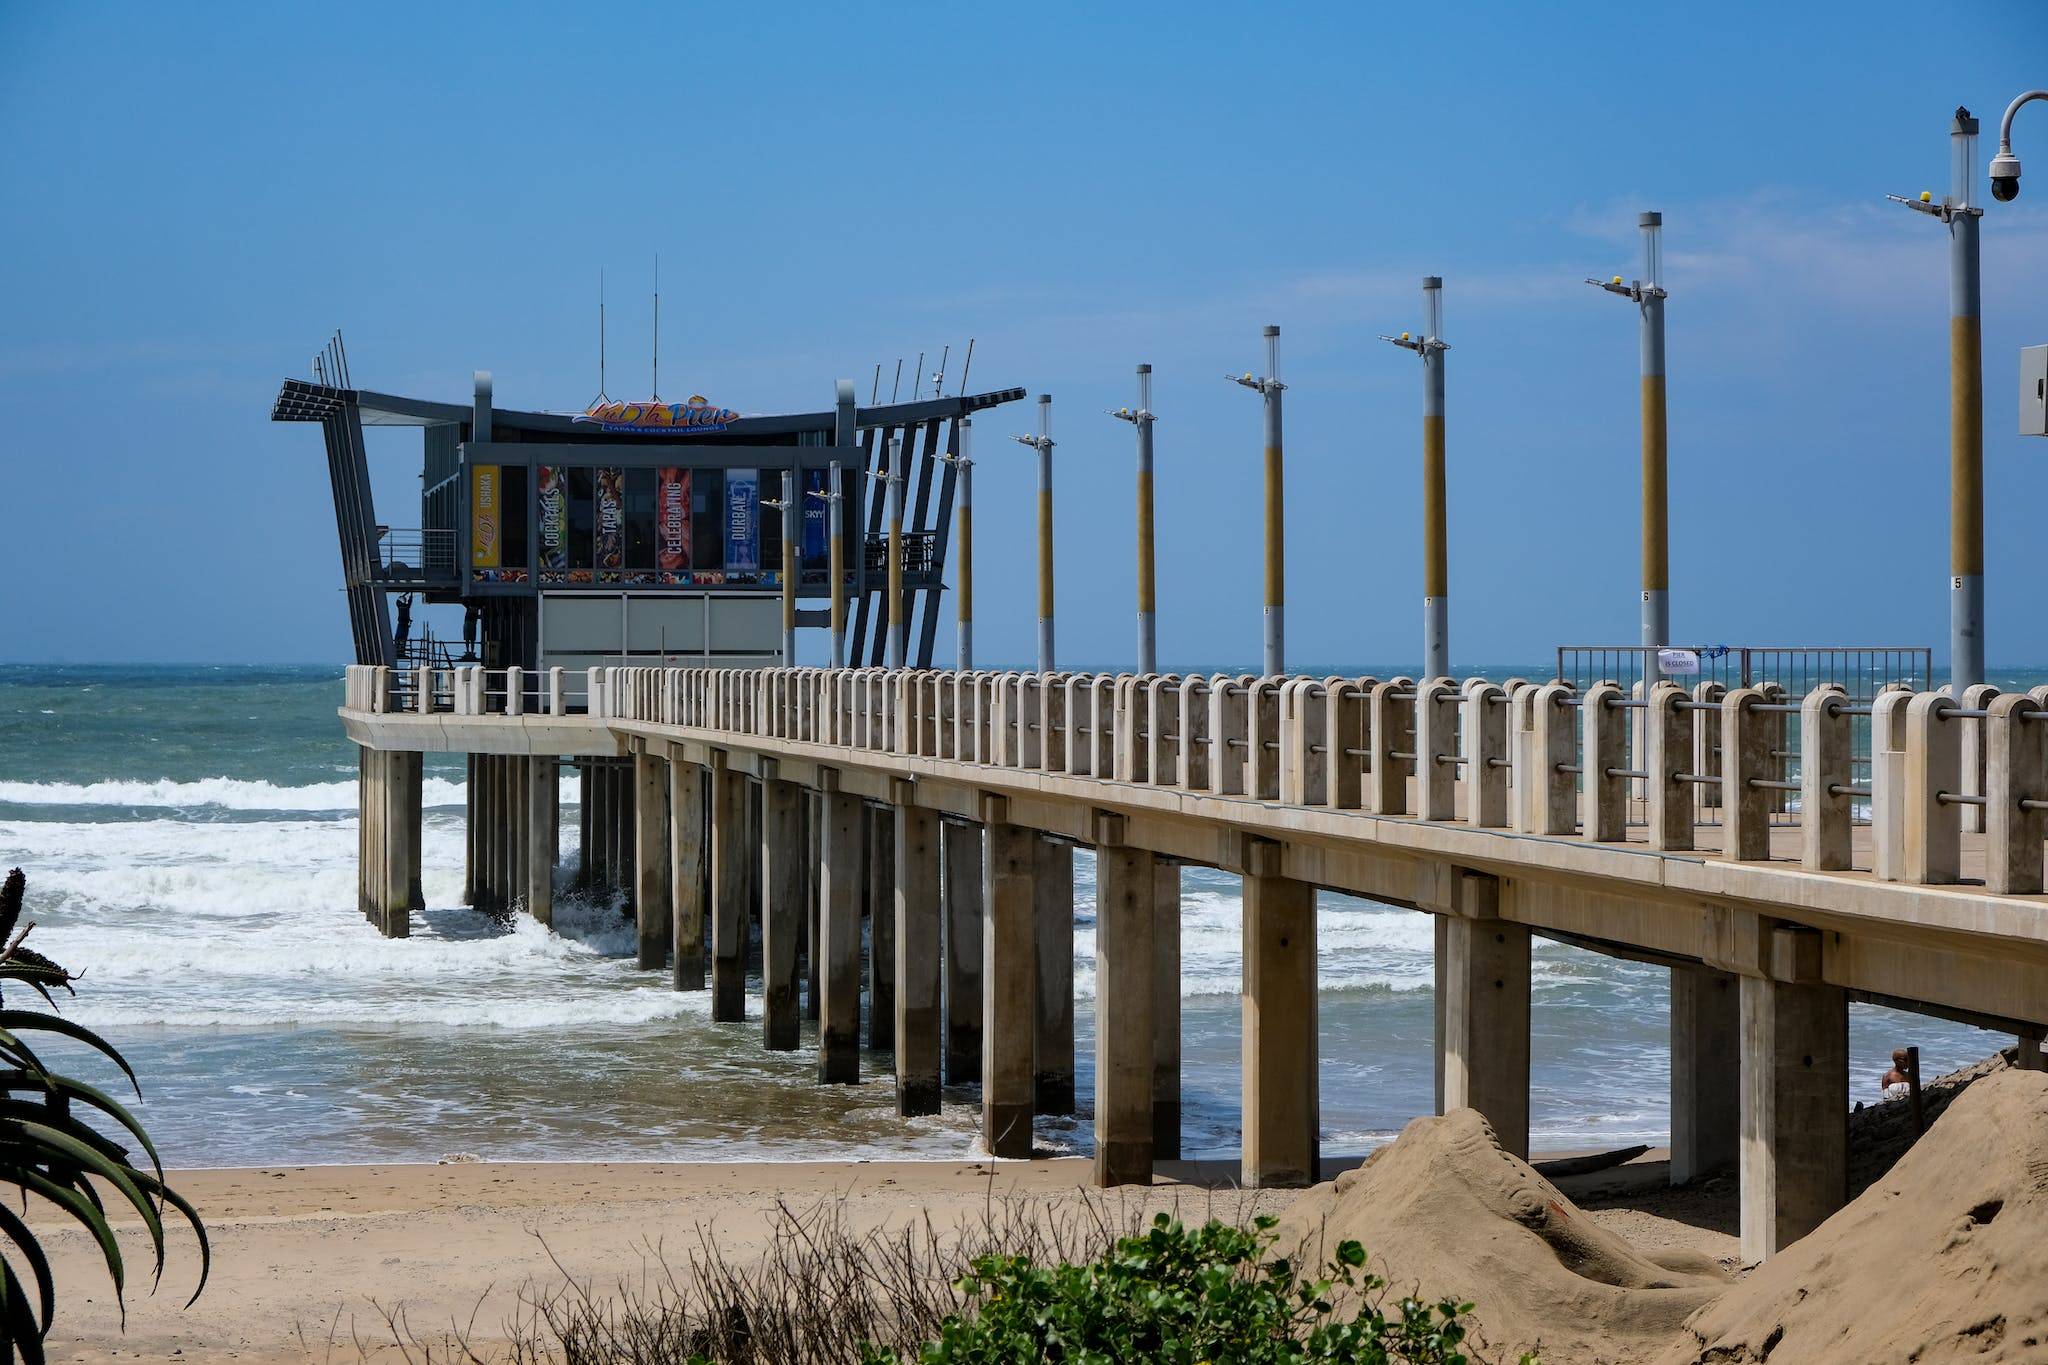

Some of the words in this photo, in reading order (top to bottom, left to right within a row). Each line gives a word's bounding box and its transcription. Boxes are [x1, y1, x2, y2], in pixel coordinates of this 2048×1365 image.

[667, 403, 731, 426] Pier
[480, 473, 492, 508] USHAKA
[544, 487, 560, 547] COCKTAILS
[602, 500, 617, 534] TAPAS
[667, 482, 682, 554] CELEBRATING
[731, 497, 746, 540] DURBAN
[805, 510, 824, 518] SKYY
[1643, 592, 1649, 601] 6
[1955, 577, 1961, 589] 5
